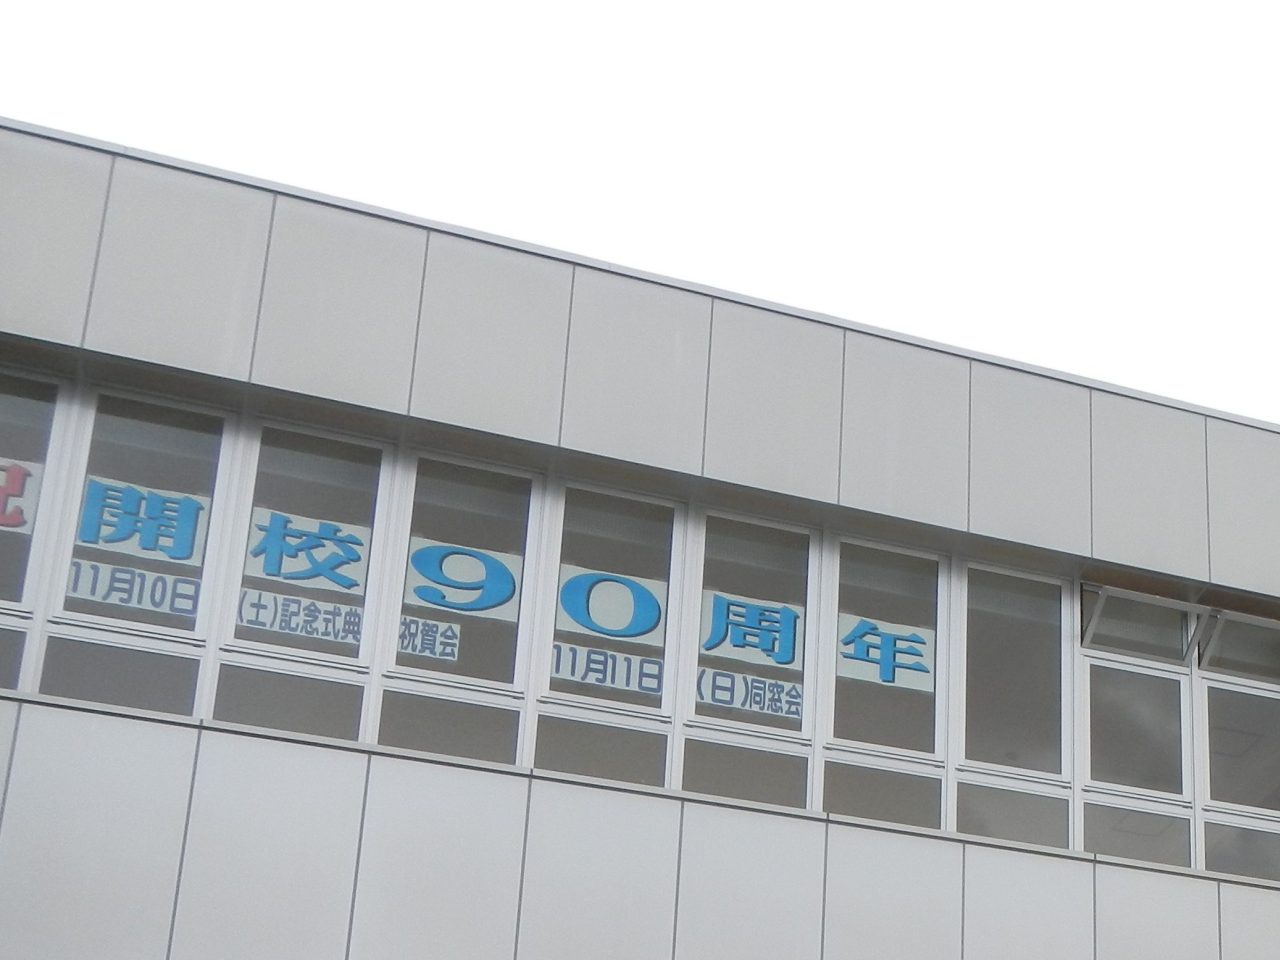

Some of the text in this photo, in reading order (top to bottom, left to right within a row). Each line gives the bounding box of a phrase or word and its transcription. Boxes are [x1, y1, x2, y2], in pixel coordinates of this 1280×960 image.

[72, 561, 458, 659] 11月10日 (土)記念式典 祝賀会
[552, 644, 802, 717] 11月11日 (日)同窓会
